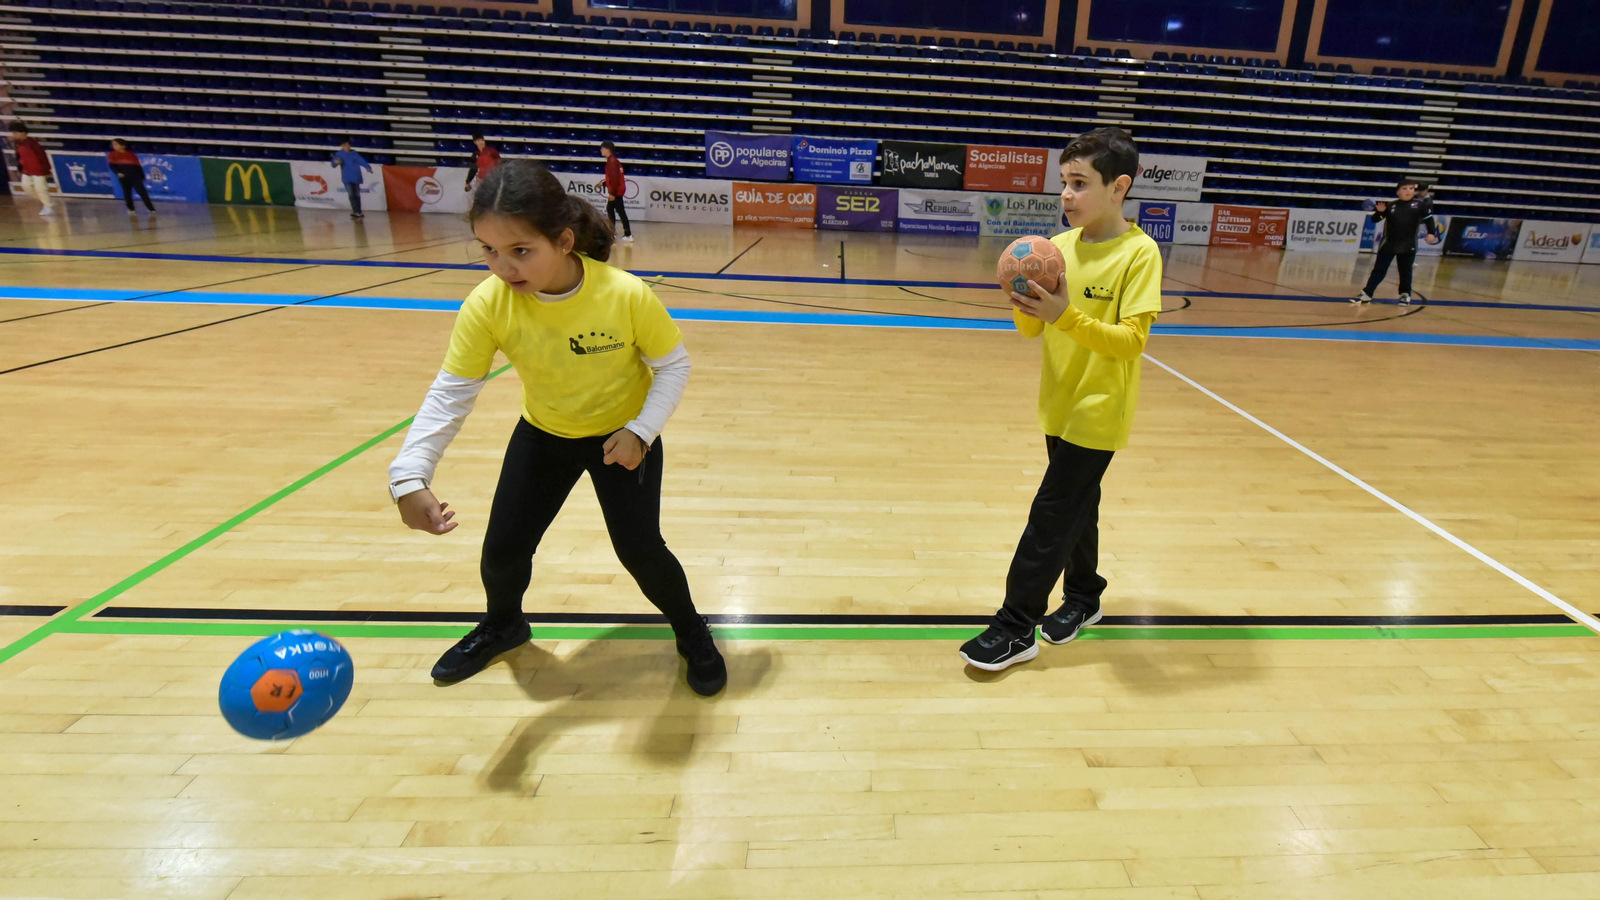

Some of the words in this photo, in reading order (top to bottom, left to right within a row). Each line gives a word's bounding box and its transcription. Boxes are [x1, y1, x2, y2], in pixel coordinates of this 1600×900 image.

[715, 149, 729, 161] PP
[736, 147, 788, 158] populares
[809, 145, 848, 155] Domino's
[850, 147, 873, 156] Pizza
[970, 149, 1044, 165] Socialistas
[751, 157, 787, 167] Algeciras
[978, 162, 1006, 170] Algeciras
[1143, 165, 1202, 183] algetoner
[650, 190, 729, 205] OKEYMAS
[765, 191, 784, 204] DE
[787, 192, 815, 205] OCIO
[836, 195, 880, 212] SER
[1006, 197, 1025, 210] Los
[1028, 198, 1058, 211] Pinos
[650, 203, 697, 211] FITNESS
[1219, 224, 1249, 232] CENTRO
[1290, 220, 1358, 236] IBERSUR
[1523, 230, 1570, 247] Adedi
[586, 341, 625, 353] Balonmano
